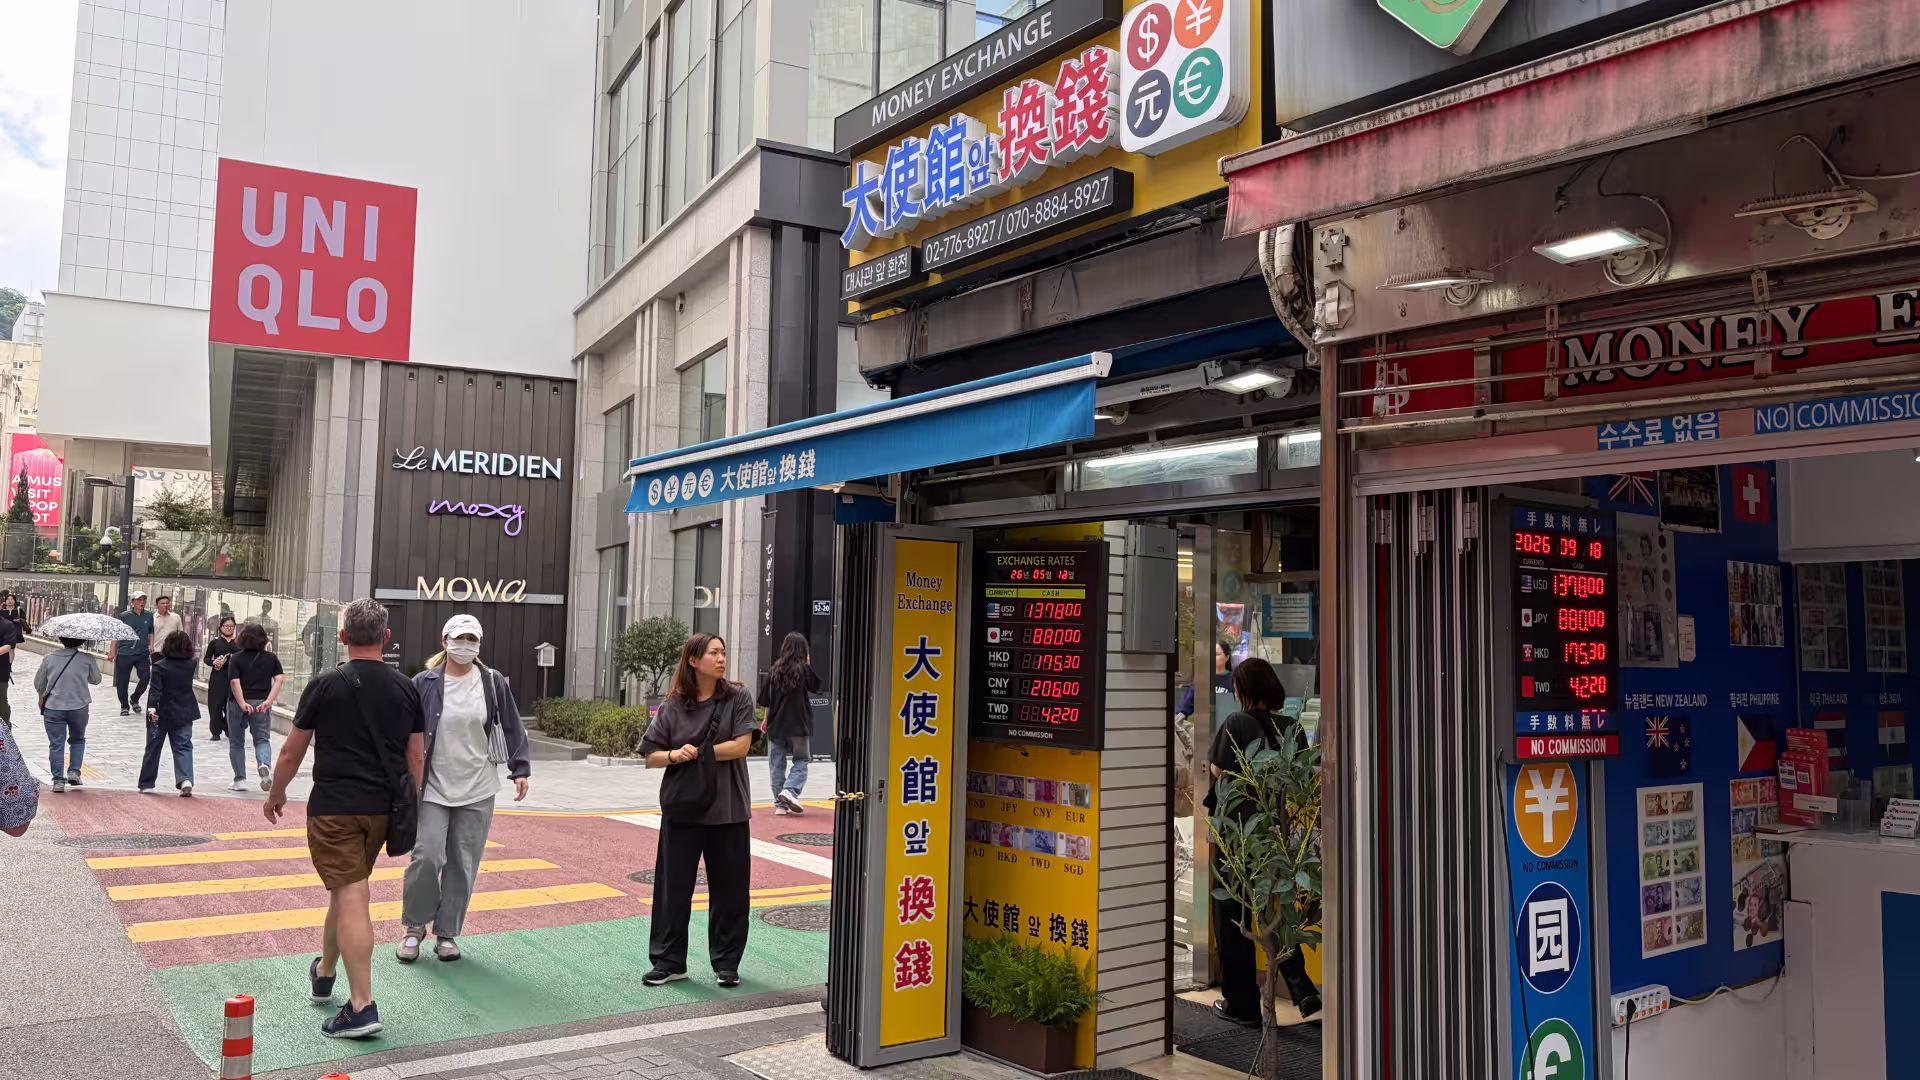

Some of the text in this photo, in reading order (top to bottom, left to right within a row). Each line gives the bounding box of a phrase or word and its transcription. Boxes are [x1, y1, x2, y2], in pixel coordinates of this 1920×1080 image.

[871, 11, 1053, 127] MONEY EXCHANGE
[1133, 80, 1163, 129] 元
[241, 186, 379, 262] UNI
[925, 220, 996, 264] 02-776-8927
[1006, 176, 1109, 235] 070-8884-8927
[845, 252, 908, 293] 대사관 앞 환전
[237, 263, 389, 335] QLO
[1564, 304, 1818, 387] MONEY
[1756, 406, 1789, 431] NO
[1599, 411, 1719, 449] 수수료 없음
[392, 446, 562, 480] Le MERIDIEN
[429, 500, 525, 536] moxy
[997, 555, 1075, 566] EXCHANGE RATES
[906, 571, 943, 592] Money
[1533, 580, 1547, 590] USD
[988, 589, 1014, 597] CURRENCY
[897, 594, 953, 614] Exchange
[1001, 605, 1015, 613] USD
[1534, 613, 1548, 624] JPY
[1000, 630, 1014, 638] JPY
[988, 651, 1010, 662] HKD
[1534, 648, 1549, 659] HKD
[988, 678, 1009, 688] CNY
[1535, 682, 1550, 692] TWD
[987, 703, 1008, 713] TWD
[1624, 693, 1708, 710] 뉴질랜드 NEW ZEALAND
[1018, 730, 1053, 739] COMMISSION
[1531, 738, 1606, 755] NO COMMISSION
[1001, 802, 1018, 813] JPY
[1033, 806, 1052, 818] CNY
[1065, 811, 1085, 823] EUR
[997, 851, 1018, 863] HKD
[1030, 857, 1050, 869] TWD
[1063, 863, 1084, 876] SGD
[1523, 858, 1578, 873] NO COMMISSION
[1028, 915, 1041, 938] 앞
[1049, 912, 1089, 951] 換錢
